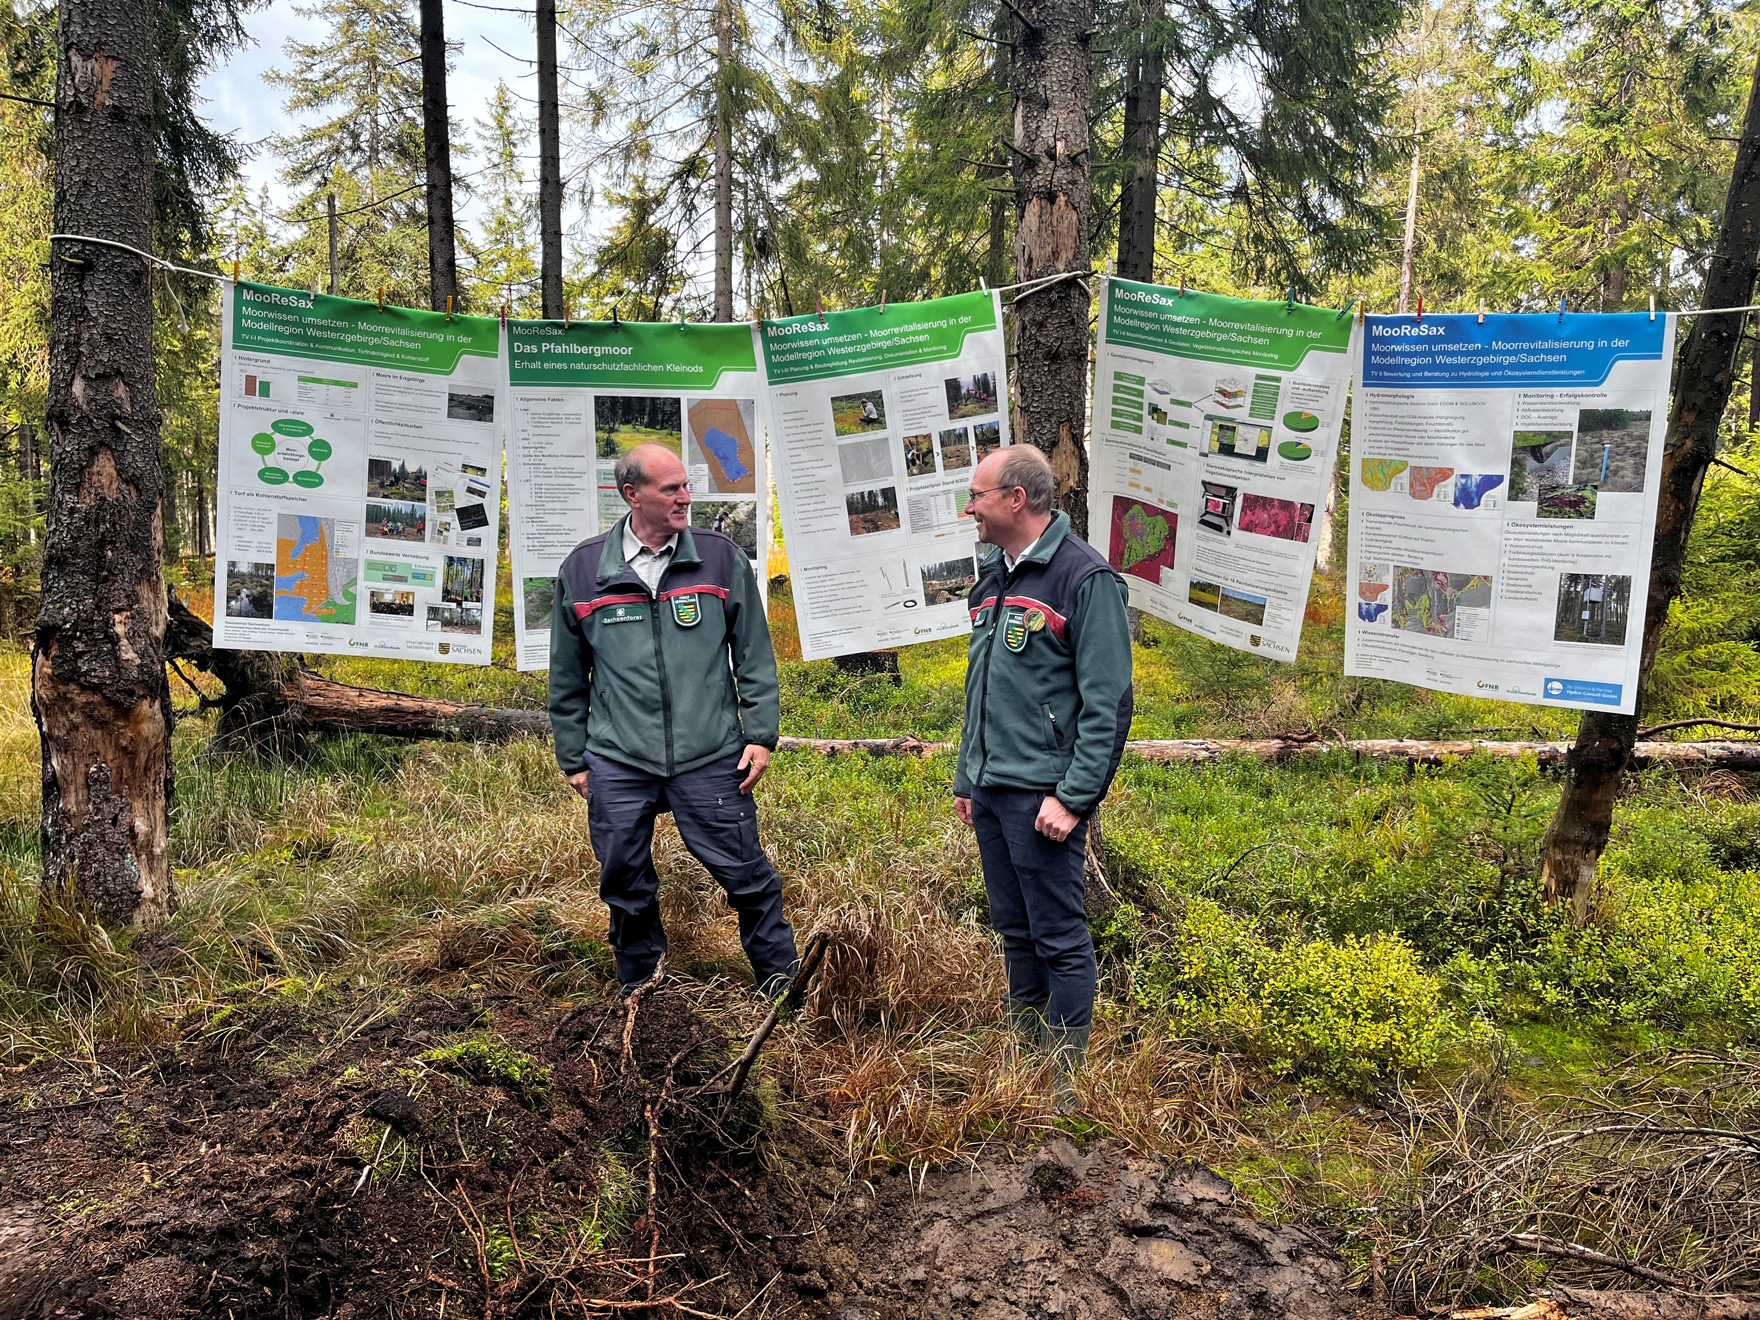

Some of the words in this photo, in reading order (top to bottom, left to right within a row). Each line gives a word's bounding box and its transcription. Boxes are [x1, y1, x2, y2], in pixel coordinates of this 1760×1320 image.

[243, 289, 314, 309] MooReSax
[1115, 288, 1174, 306] MooReSax
[242, 307, 299, 322] Moorwissen
[302, 316, 348, 328] umsetzen
[358, 322, 444, 342] Moorrevitalisierung
[447, 333, 454, 342] in
[457, 335, 472, 344] der
[1114, 304, 1158, 319] Moorwissen
[1160, 313, 1200, 324] umsetzen
[1209, 318, 1293, 337] Moorrevitalisierung
[1296, 328, 1304, 336] in
[1307, 330, 1322, 338] der
[242, 319, 303, 335] Modellregion
[306, 327, 421, 349] Westerzgebirge/Sachsen
[513, 326, 566, 335] MooReSax:
[767, 322, 830, 337] MooReSax
[770, 338, 820, 351] Moorwissen
[822, 332, 862, 344] umsetzen
[870, 320, 947, 338] Moorrevitalisierung
[949, 318, 956, 326] in
[958, 316, 972, 324] der
[1114, 316, 1160, 330] Modellregion
[1162, 324, 1270, 345] Westerzgebirge/Sachsen
[1372, 325, 1445, 336] MooReSax
[258, 336, 308, 347] Projektkoordination
[315, 343, 356, 353] Kommunikation,
[514, 342, 538, 353] Das
[542, 343, 633, 356] Pfahlbergmoor
[772, 349, 825, 363] Modellregion
[827, 333, 929, 356] Westerzgebirge/Sachsen
[1126, 332, 1163, 342] Moorinformationen
[1169, 340, 1191, 348] Geodaten,
[1193, 343, 1251, 355] Vegetationsökologisches
[1252, 350, 1278, 359] Monitoring
[1371, 343, 1428, 352] Moorwissen
[1432, 342, 1481, 351] umsetzen
[1492, 339, 1594, 350] Moorrevitalisierung
[1598, 339, 1607, 348] in
[1611, 338, 1630, 347] der
[238, 356, 270, 364] Hintergrund
[515, 360, 541, 369] Erhalt
[544, 361, 567, 369] eines
[570, 361, 663, 372] naturschutzfachlichen
[666, 364, 703, 372] Kleinods
[815, 359, 848, 369] Baubegleitung
[884, 349, 918, 359] Dokumentation
[1111, 353, 1154, 364] Geodatenmanagement
[1372, 355, 1432, 366] Modellregion
[1435, 354, 1566, 366] Westerzgebirge/Sachsen
[237, 404, 276, 413] Projektstruktur
[375, 419, 423, 430] Öffentlichkeitsarbeit
[1206, 464, 1243, 474] Stereoskopische
[1244, 470, 1275, 479] Interpretation
[1236, 580, 1288, 595] Revitalisierungsobjekte
[603, 615, 642, 623] Sachsenforst
[1362, 630, 1400, 639] Wissenstransfer
[1262, 641, 1290, 653] SACHSEN
